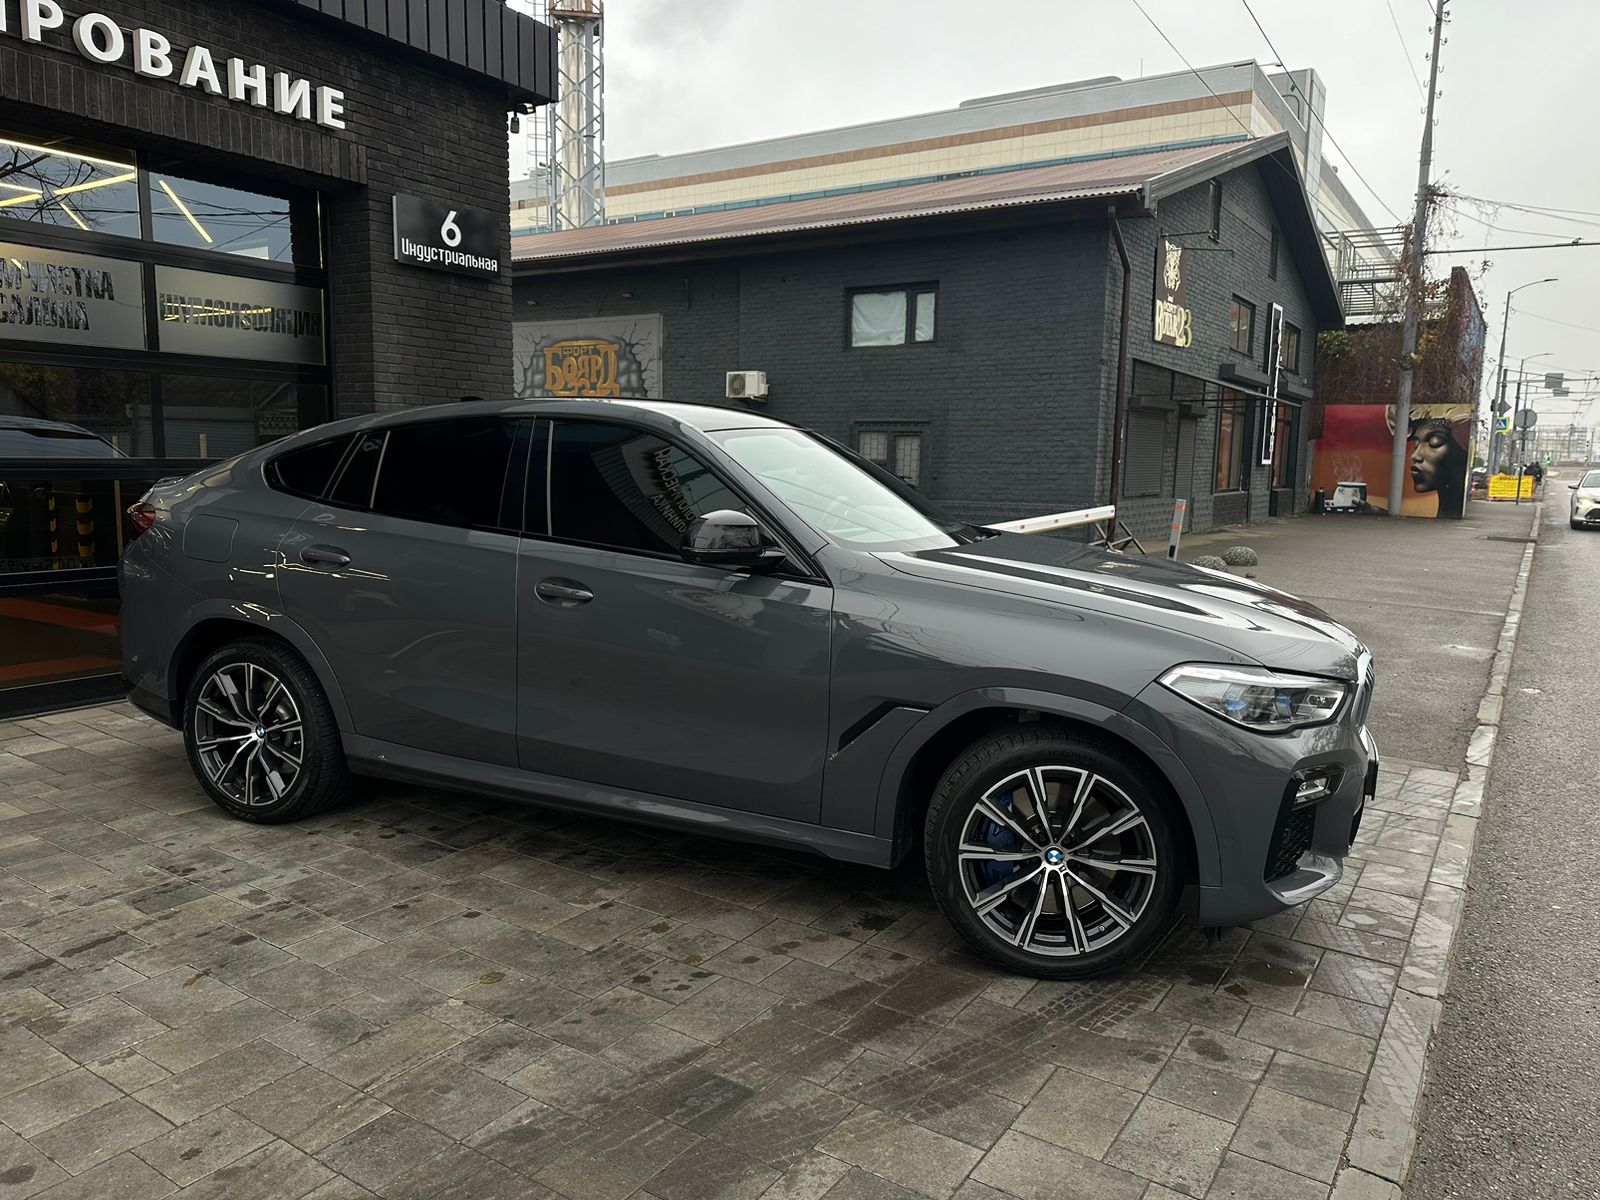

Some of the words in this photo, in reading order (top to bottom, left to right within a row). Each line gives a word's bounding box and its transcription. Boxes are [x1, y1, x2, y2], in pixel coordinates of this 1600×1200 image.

[0, 0, 346, 129] РОВАНИЕ
[441, 210, 461, 247] 6
[401, 237, 498, 272] Индустриальная
[563, 345, 594, 357] ФОРТ
[544, 344, 620, 397] БОЯРД
